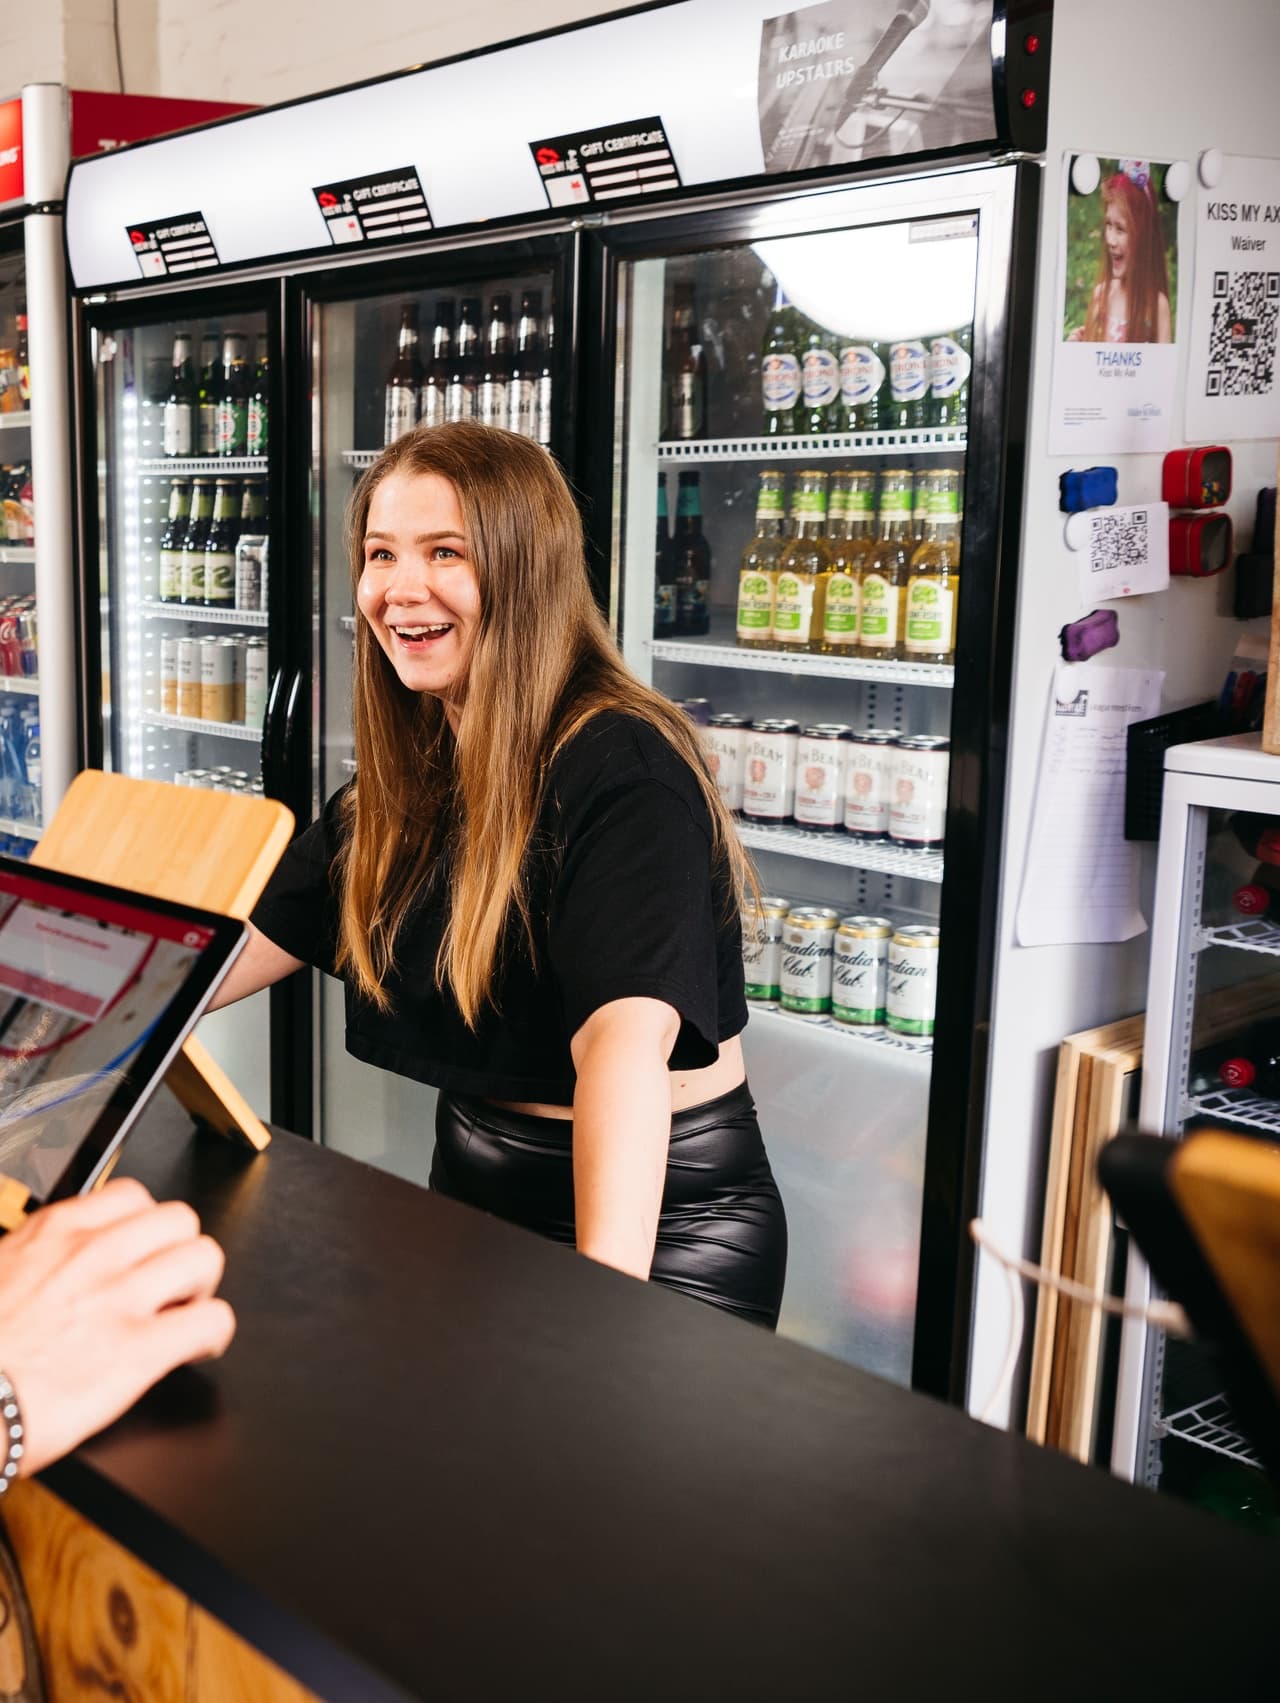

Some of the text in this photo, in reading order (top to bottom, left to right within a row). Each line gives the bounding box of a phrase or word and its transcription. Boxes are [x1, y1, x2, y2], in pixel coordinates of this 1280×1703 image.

[777, 31, 846, 63] KARAOKE
[775, 56, 855, 89] UPSTAIRS
[580, 130, 665, 157] GIFT CERTIFICATE
[353, 187, 373, 201] GIFT
[1207, 202, 1239, 222] KISS
[1241, 204, 1262, 223] MY
[1231, 236, 1267, 252] Waiver
[1095, 350, 1143, 367] THANKS
